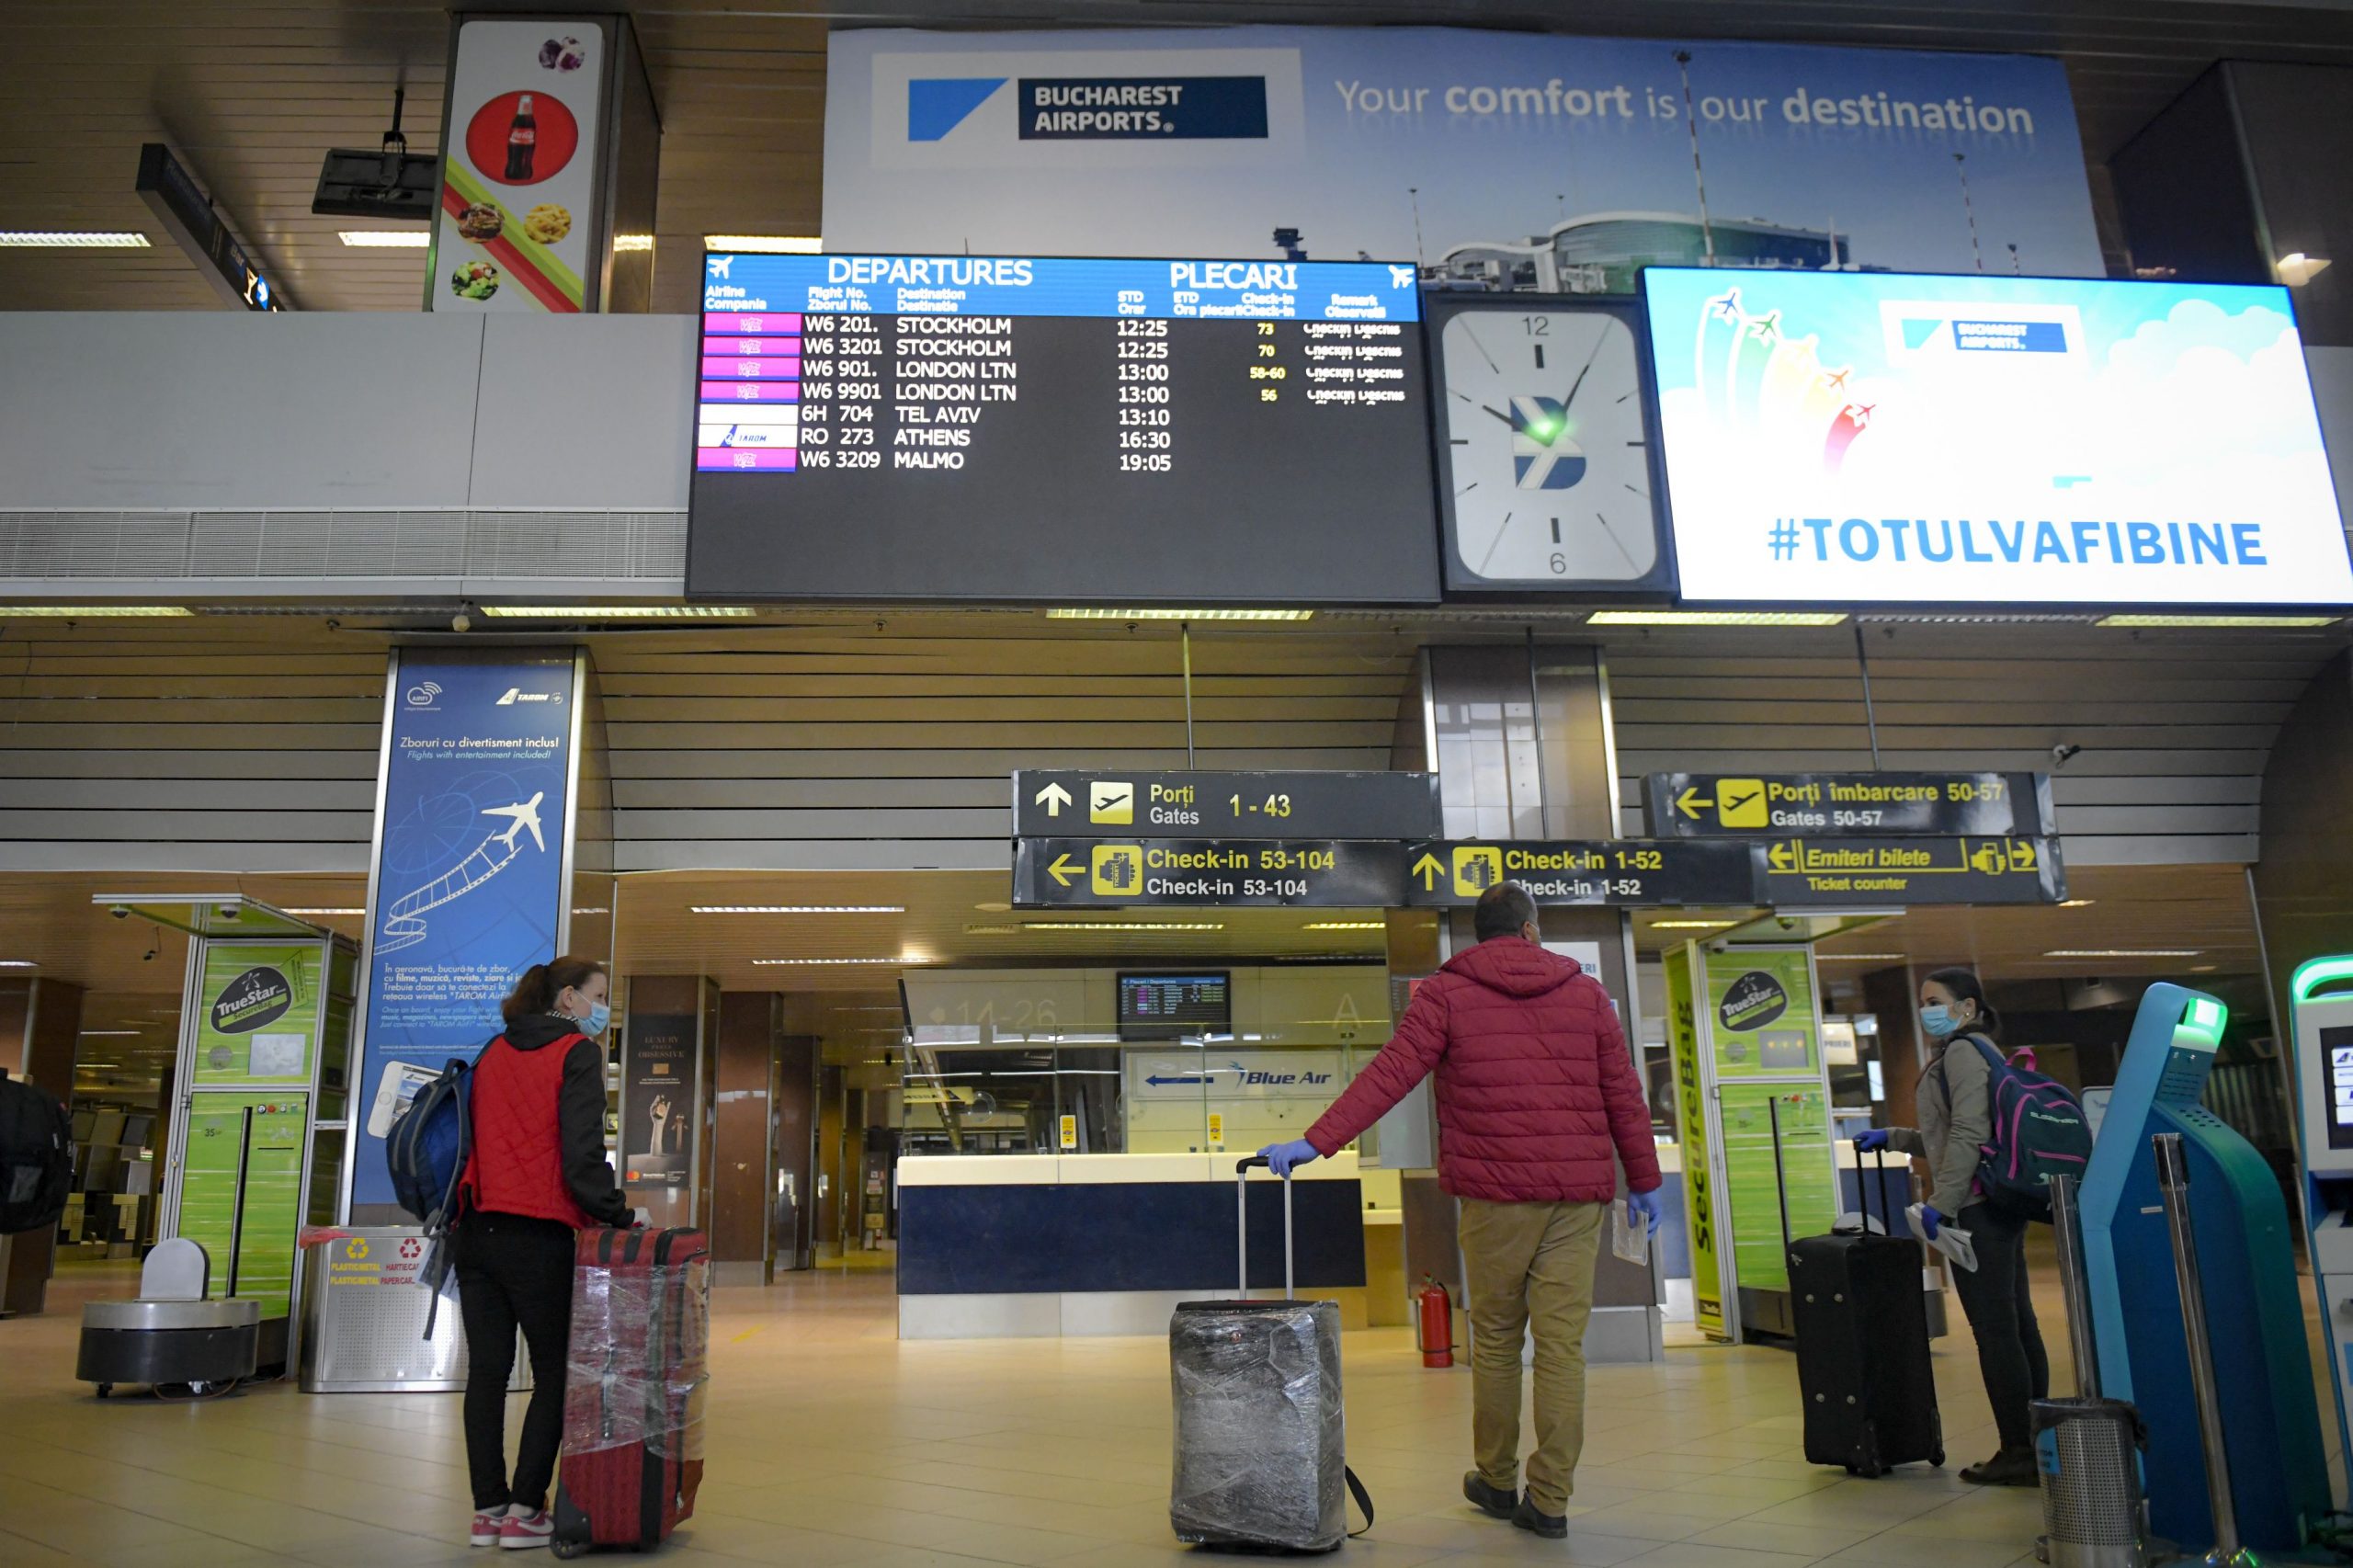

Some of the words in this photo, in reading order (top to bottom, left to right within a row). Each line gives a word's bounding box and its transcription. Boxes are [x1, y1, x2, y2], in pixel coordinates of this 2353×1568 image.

[1034, 85, 1183, 107] BUCHAREST
[1334, 80, 1429, 113] Your
[1444, 79, 1633, 118] comfort
[1646, 87, 1677, 118] is
[1700, 96, 1768, 121] our
[1782, 87, 2034, 134] destination
[1034, 110, 1161, 131] AIRPORTS
[827, 257, 1033, 286] DEPARTURES
[1170, 262, 1298, 290] PLECARI
[804, 315, 835, 333] W6
[839, 316, 878, 333] 201.
[896, 317, 1012, 335] STOCKHOLM
[1117, 320, 1168, 336] 12:25
[1257, 323, 1275, 335] 73
[1521, 316, 1550, 336] 12
[803, 337, 834, 355] W6
[838, 338, 882, 355] 3201
[896, 339, 1012, 357] STOCKHOLM
[1118, 342, 1168, 358] 12:25
[1257, 345, 1275, 358] 70
[802, 360, 833, 377] W6
[837, 360, 877, 377] 901.
[895, 360, 975, 379] LONDON
[981, 361, 1017, 379] LTN
[1118, 364, 1169, 381] 13:00
[1249, 367, 1286, 380] 58-60
[802, 382, 833, 399] W6
[837, 382, 881, 400] 9901
[895, 383, 975, 401] LONDON
[981, 384, 1017, 401] LTN
[1119, 386, 1169, 403] 13:00
[1260, 389, 1278, 402] 56
[801, 404, 827, 422] 6H
[838, 405, 873, 422] 704
[894, 406, 931, 423] TEL
[934, 406, 982, 424] AVIV
[1119, 409, 1170, 426] 13:10
[801, 427, 829, 445] RO
[839, 428, 874, 445] 273
[893, 428, 971, 446] ATHENS
[1120, 431, 1171, 449] 16:30
[800, 450, 830, 468] W6
[835, 451, 881, 468] 3209
[893, 451, 964, 469] MALMO
[1120, 454, 1172, 472] 19:05
[1768, 517, 2268, 566] #TOTULVAFIBINE
[1550, 552, 1567, 574] 6
[400, 736, 439, 748] Zboruri
[442, 740, 456, 748] cu
[458, 736, 522, 748] divertisment
[525, 735, 560, 748] inclus!
[406, 750, 434, 761] Flights
[436, 750, 453, 759] with
[455, 751, 511, 759] entertainment
[513, 750, 551, 759] included!
[1150, 784, 1194, 809] Porți
[1828, 782, 1938, 801] îmbarcare
[1947, 783, 2003, 801] 50-57
[1149, 806, 1199, 824] Gates
[1229, 793, 1240, 817] 1
[1263, 794, 1291, 818] 43
[1770, 810, 1825, 826] Gates
[1833, 810, 1883, 826] 50-57
[1146, 848, 1249, 869] Check-in
[1259, 850, 1336, 870] 53-104
[1505, 849, 1606, 869] Check-in
[1614, 850, 1663, 869] 1-52
[1806, 847, 1875, 868] Emiteri
[1879, 849, 1931, 867] bilete
[1146, 879, 1233, 896] Check-in
[1243, 879, 1307, 896] 53-104
[1601, 879, 1642, 895] 1-52
[1807, 877, 1850, 891] Ticket
[1853, 878, 1908, 891] counter
[476, 963, 487, 973] de
[216, 984, 278, 1017] TrueStar
[415, 993, 448, 1001] wireless
[1722, 987, 1773, 1017] TrueStar
[1332, 993, 1362, 1029] A
[1246, 1072, 1295, 1085] Blue
[1299, 1071, 1332, 1085] Air
[204, 1128, 216, 1137] 35
